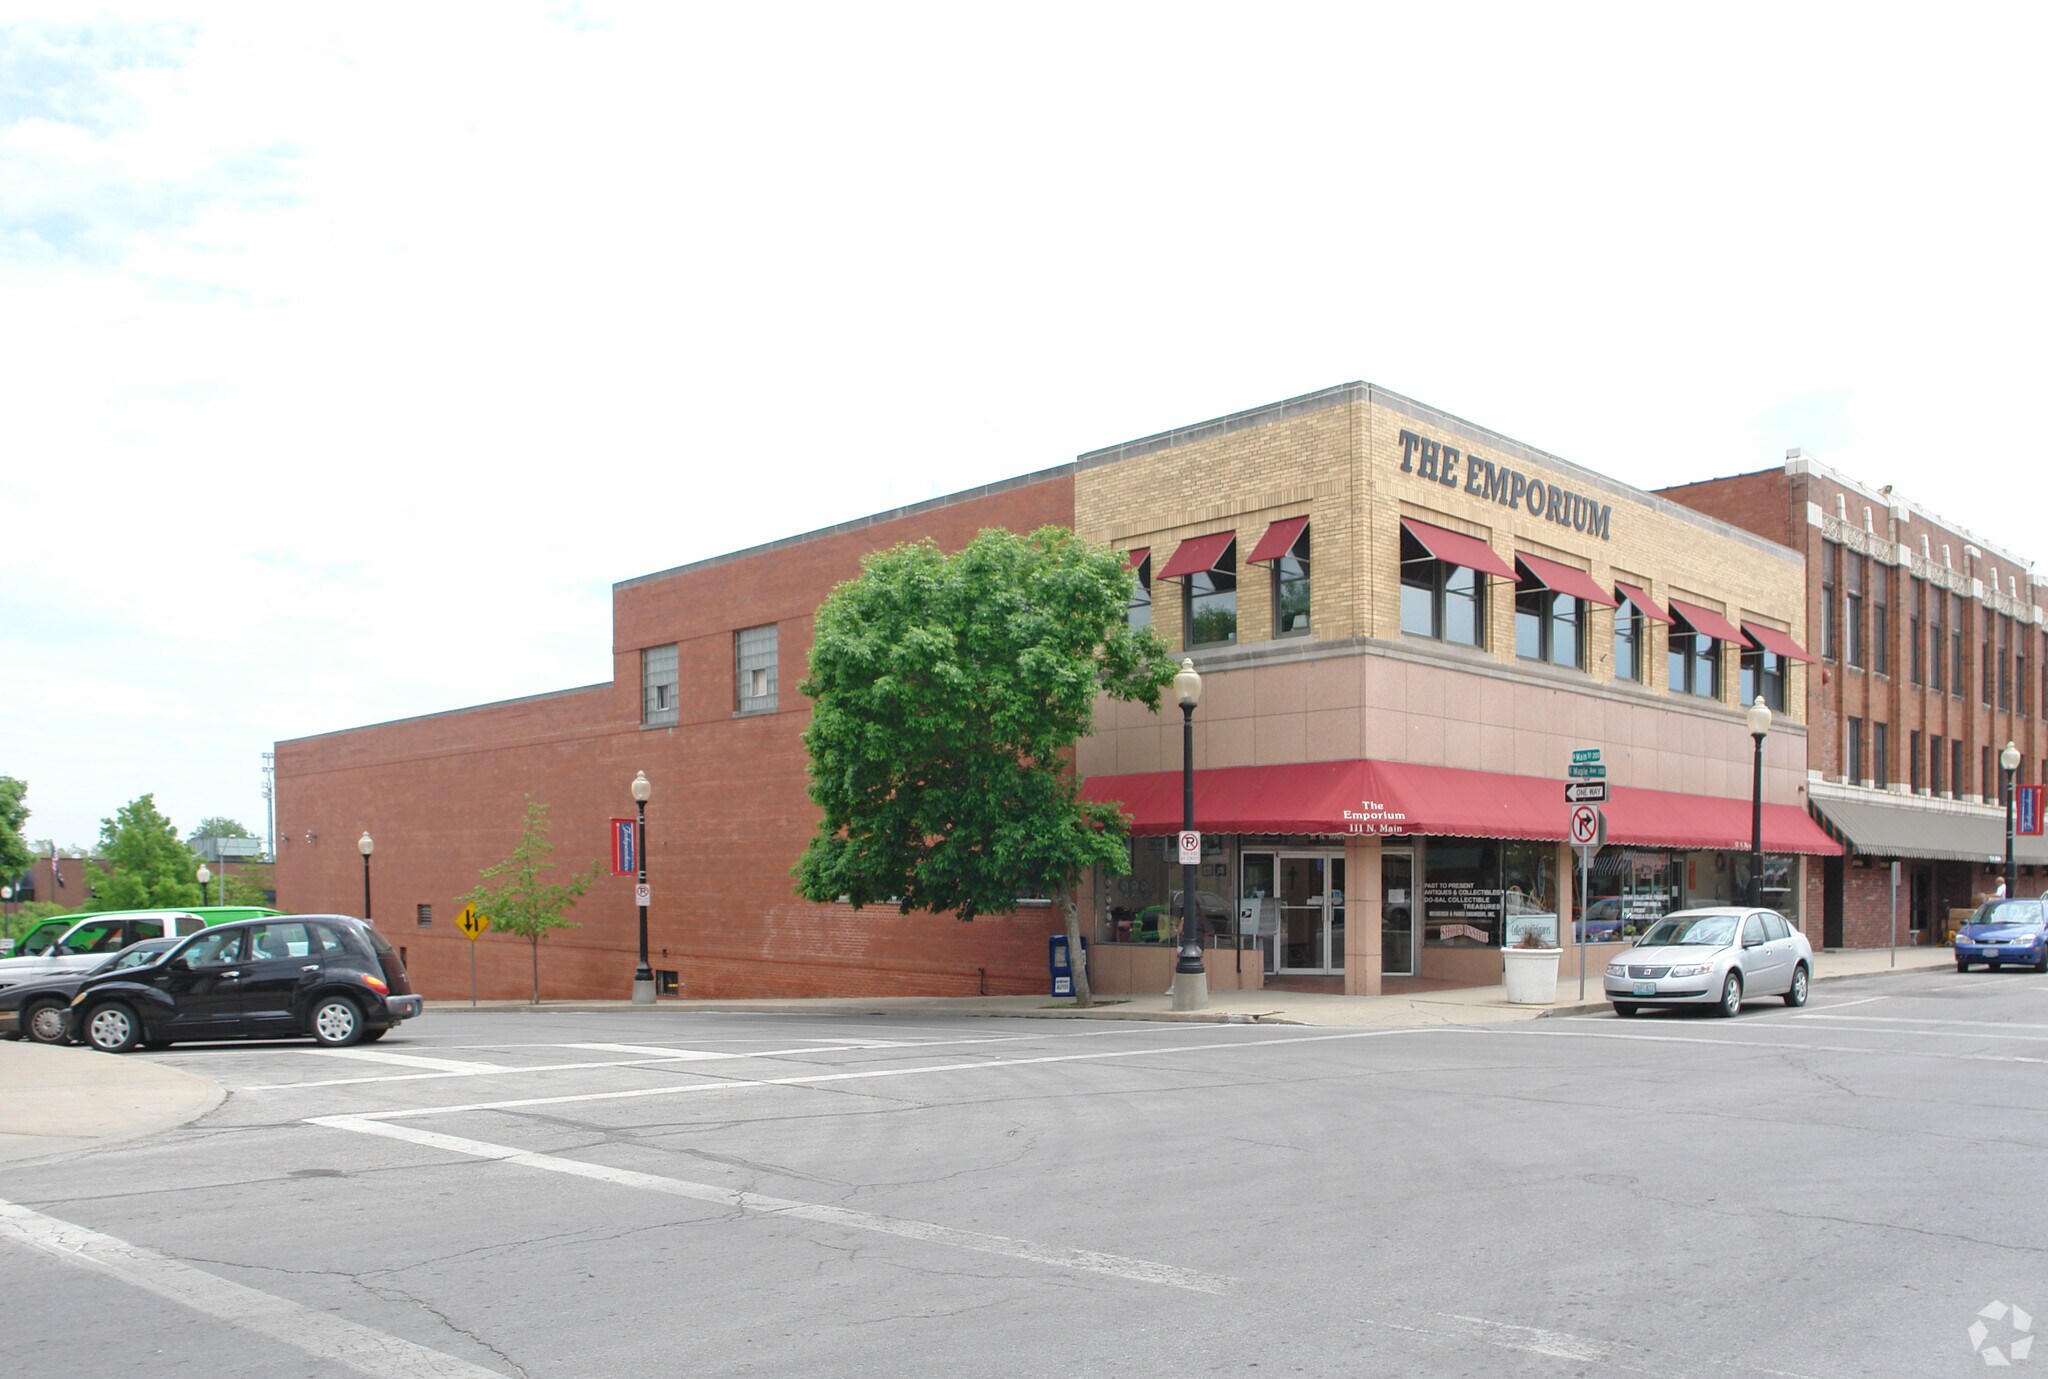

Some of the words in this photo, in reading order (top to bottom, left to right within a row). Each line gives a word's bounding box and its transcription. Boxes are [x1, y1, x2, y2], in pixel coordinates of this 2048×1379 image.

[1399, 429, 1460, 487] THE
[1464, 454, 1611, 540] EMPORIUM
[1576, 788, 1588, 796] ONE
[1589, 788, 1601, 796] WAY
[1362, 801, 1384, 810] The
[1343, 810, 1406, 820] Emporium
[1366, 824, 1377, 833] N.
[1380, 824, 1403, 833] Main
[1441, 924, 1463, 939] SHOPS
[1464, 925, 1488, 942] INSIDE
